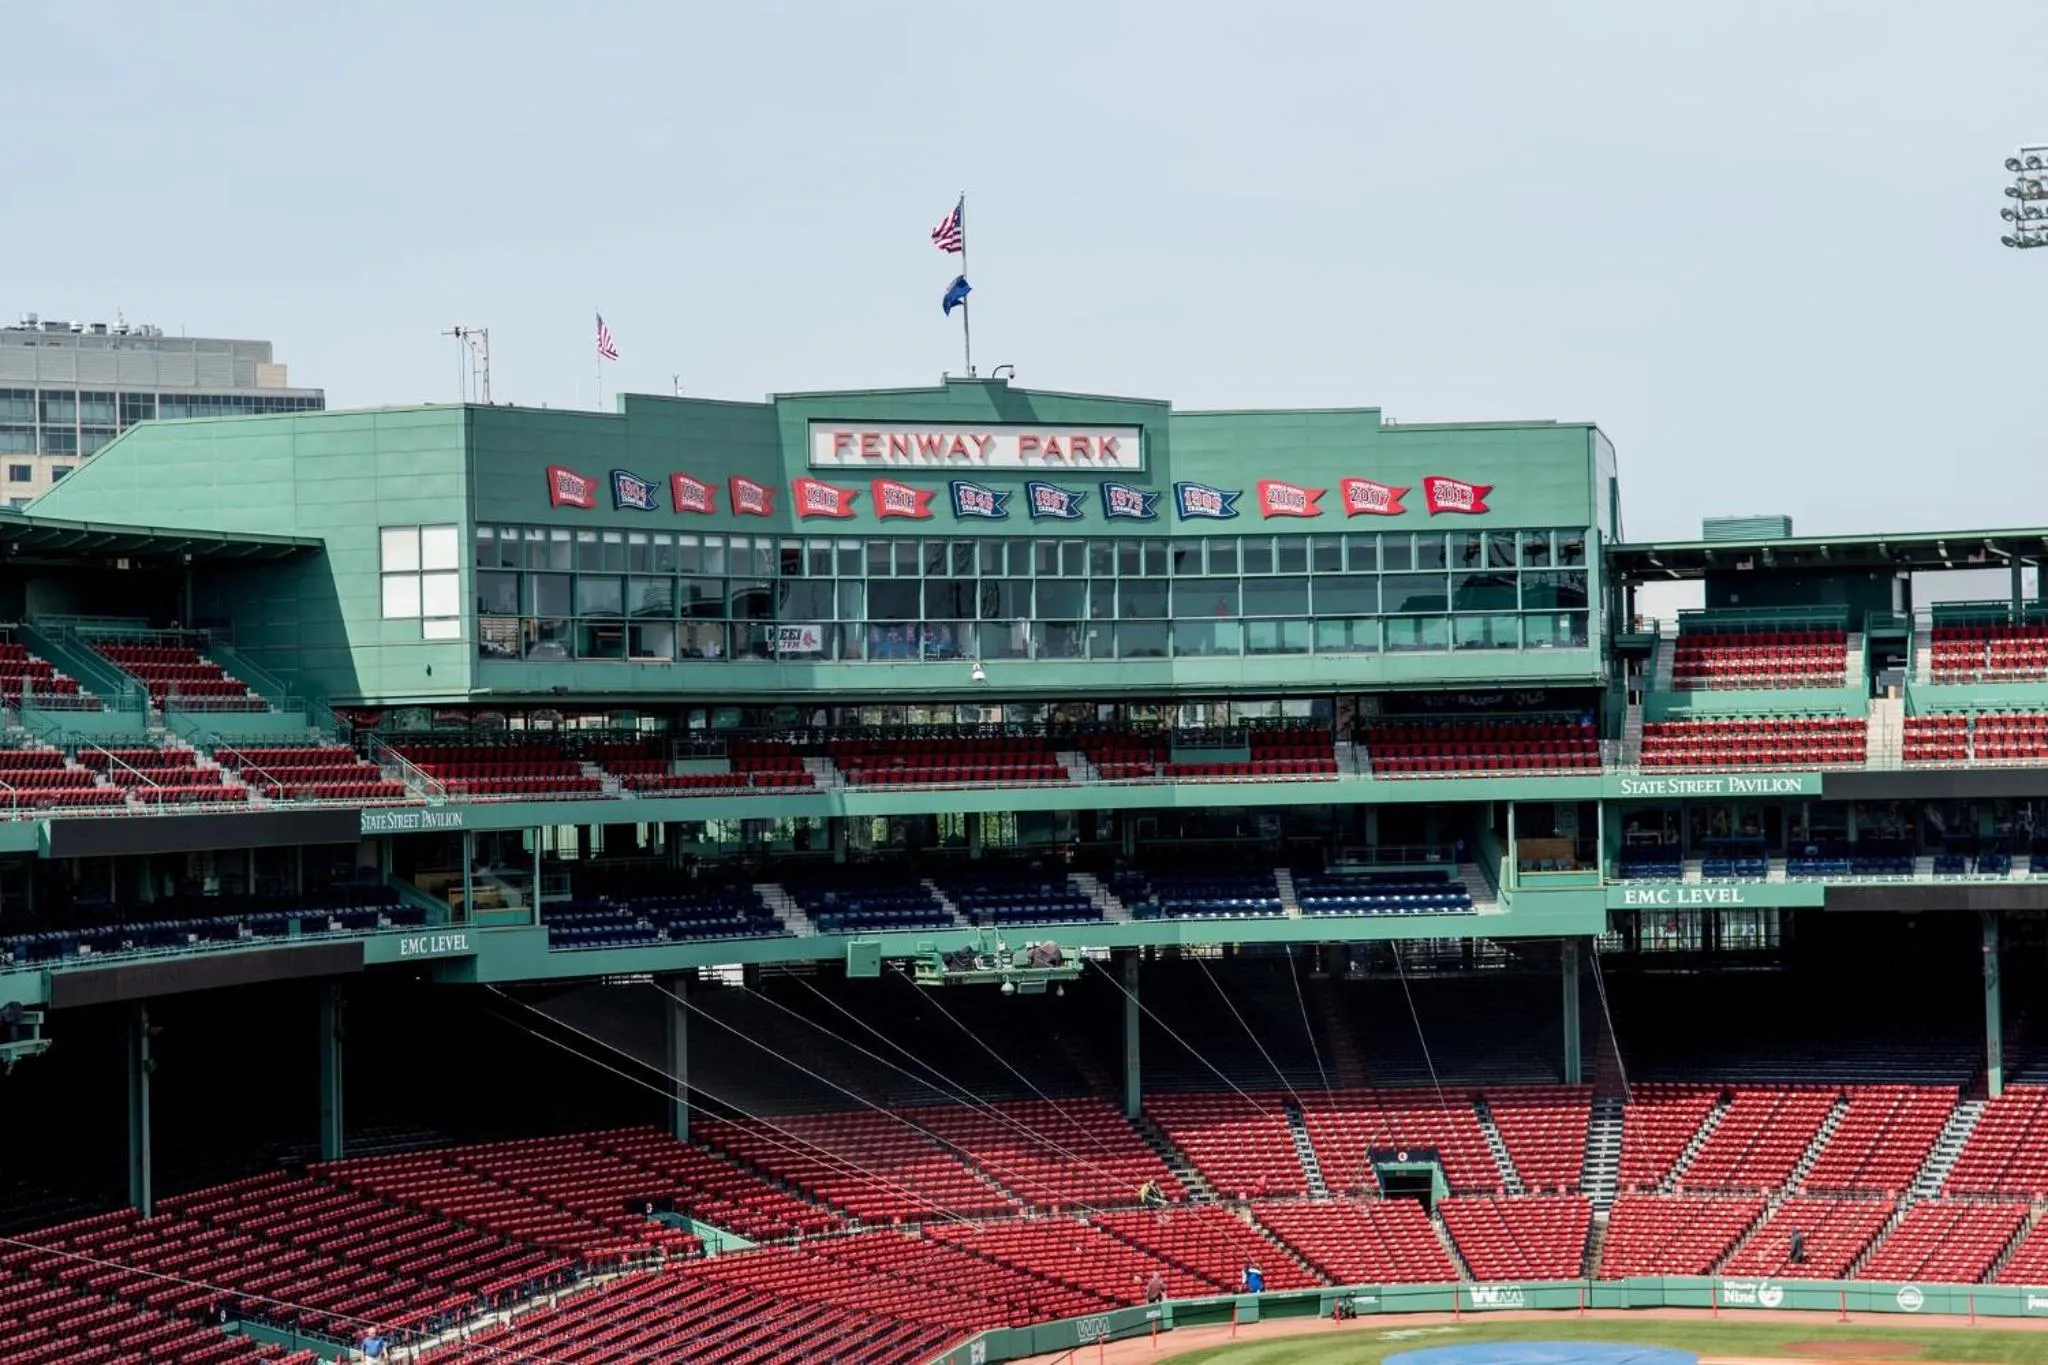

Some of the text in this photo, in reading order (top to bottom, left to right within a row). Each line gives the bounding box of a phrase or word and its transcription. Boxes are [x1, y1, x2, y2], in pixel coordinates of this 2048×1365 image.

[833, 432, 1119, 461] FENWAY PARK
[959, 488, 994, 510] 1946
[1109, 488, 1143, 510] 1975
[1350, 486, 1391, 507] 2007
[1433, 485, 1474, 506] 2013
[1620, 777, 1802, 795] STATE STREET PAVILION
[361, 810, 463, 831] STATE STREET PAVILION
[1624, 887, 1745, 905] EMC LEVEL
[400, 934, 470, 955] EMC LEVEL
[1469, 1284, 1526, 1303] WM
[1723, 1290, 1756, 1303] Nine
